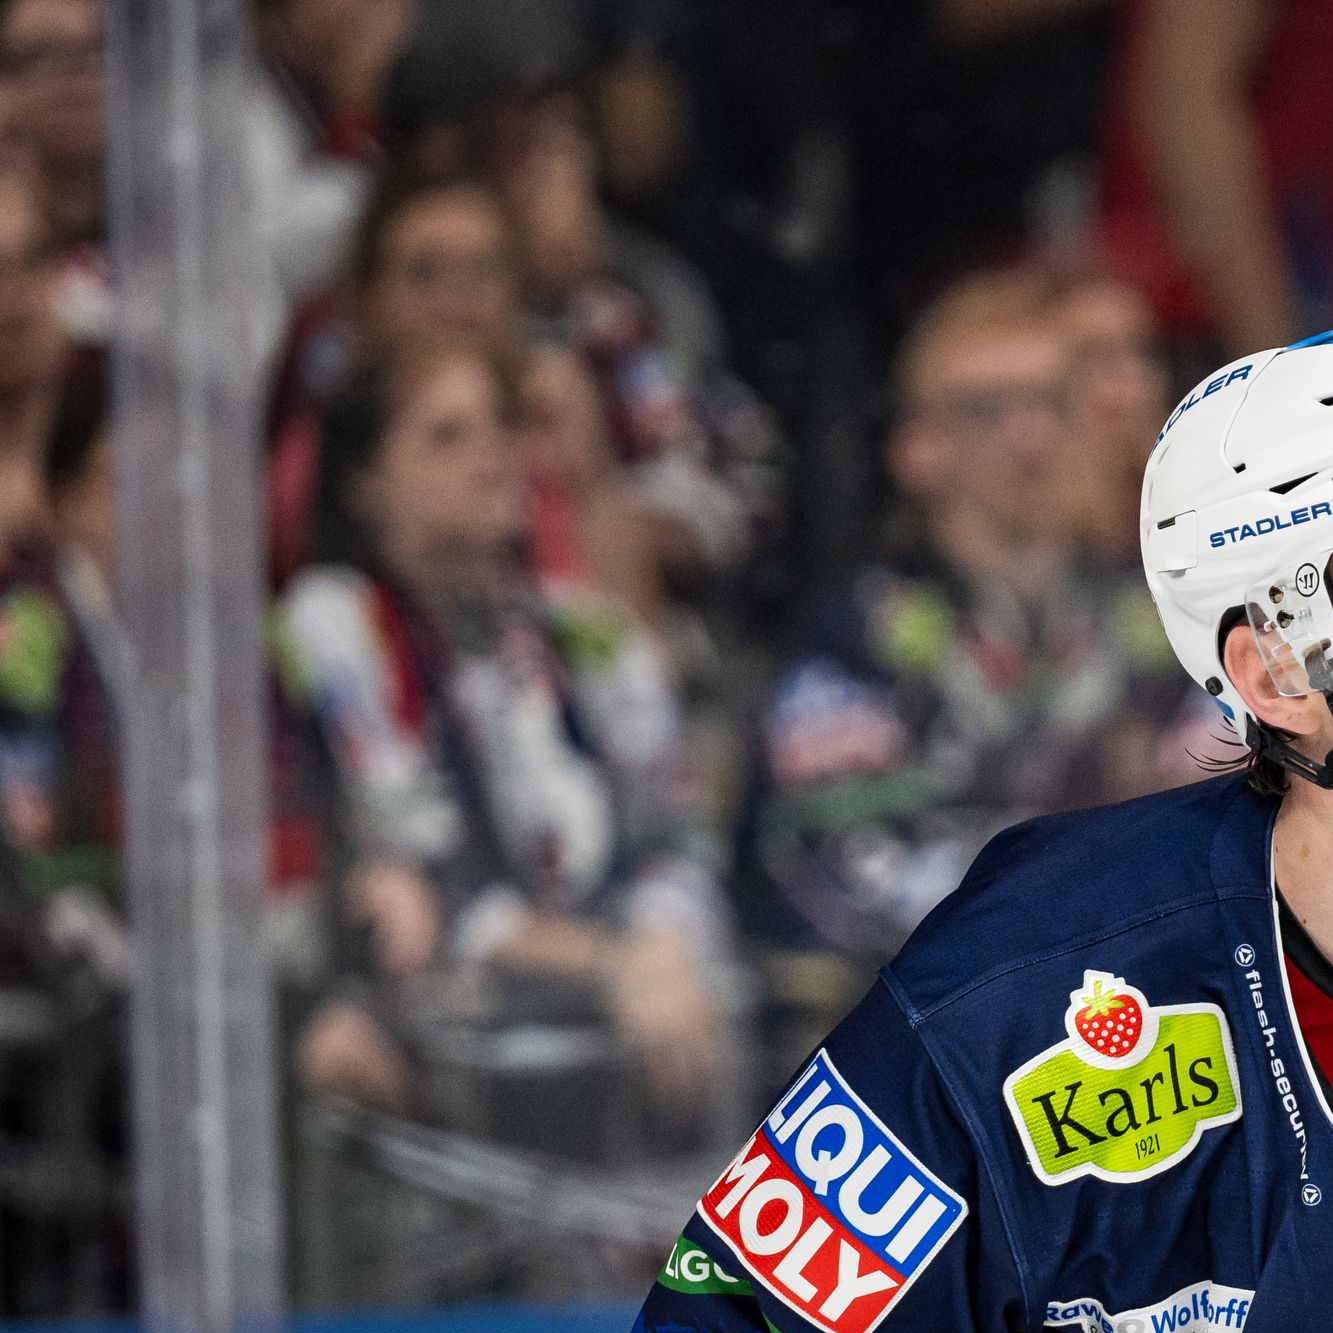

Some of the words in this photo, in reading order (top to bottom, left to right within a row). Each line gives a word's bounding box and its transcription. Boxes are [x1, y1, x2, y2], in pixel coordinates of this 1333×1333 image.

[1209, 501, 1333, 549] STADLER
[1031, 1044, 1221, 1160] Karls
[1134, 1132, 1162, 1162] 1921
[768, 1063, 948, 1265] LIQUI
[706, 1136, 900, 1323] MOLY
